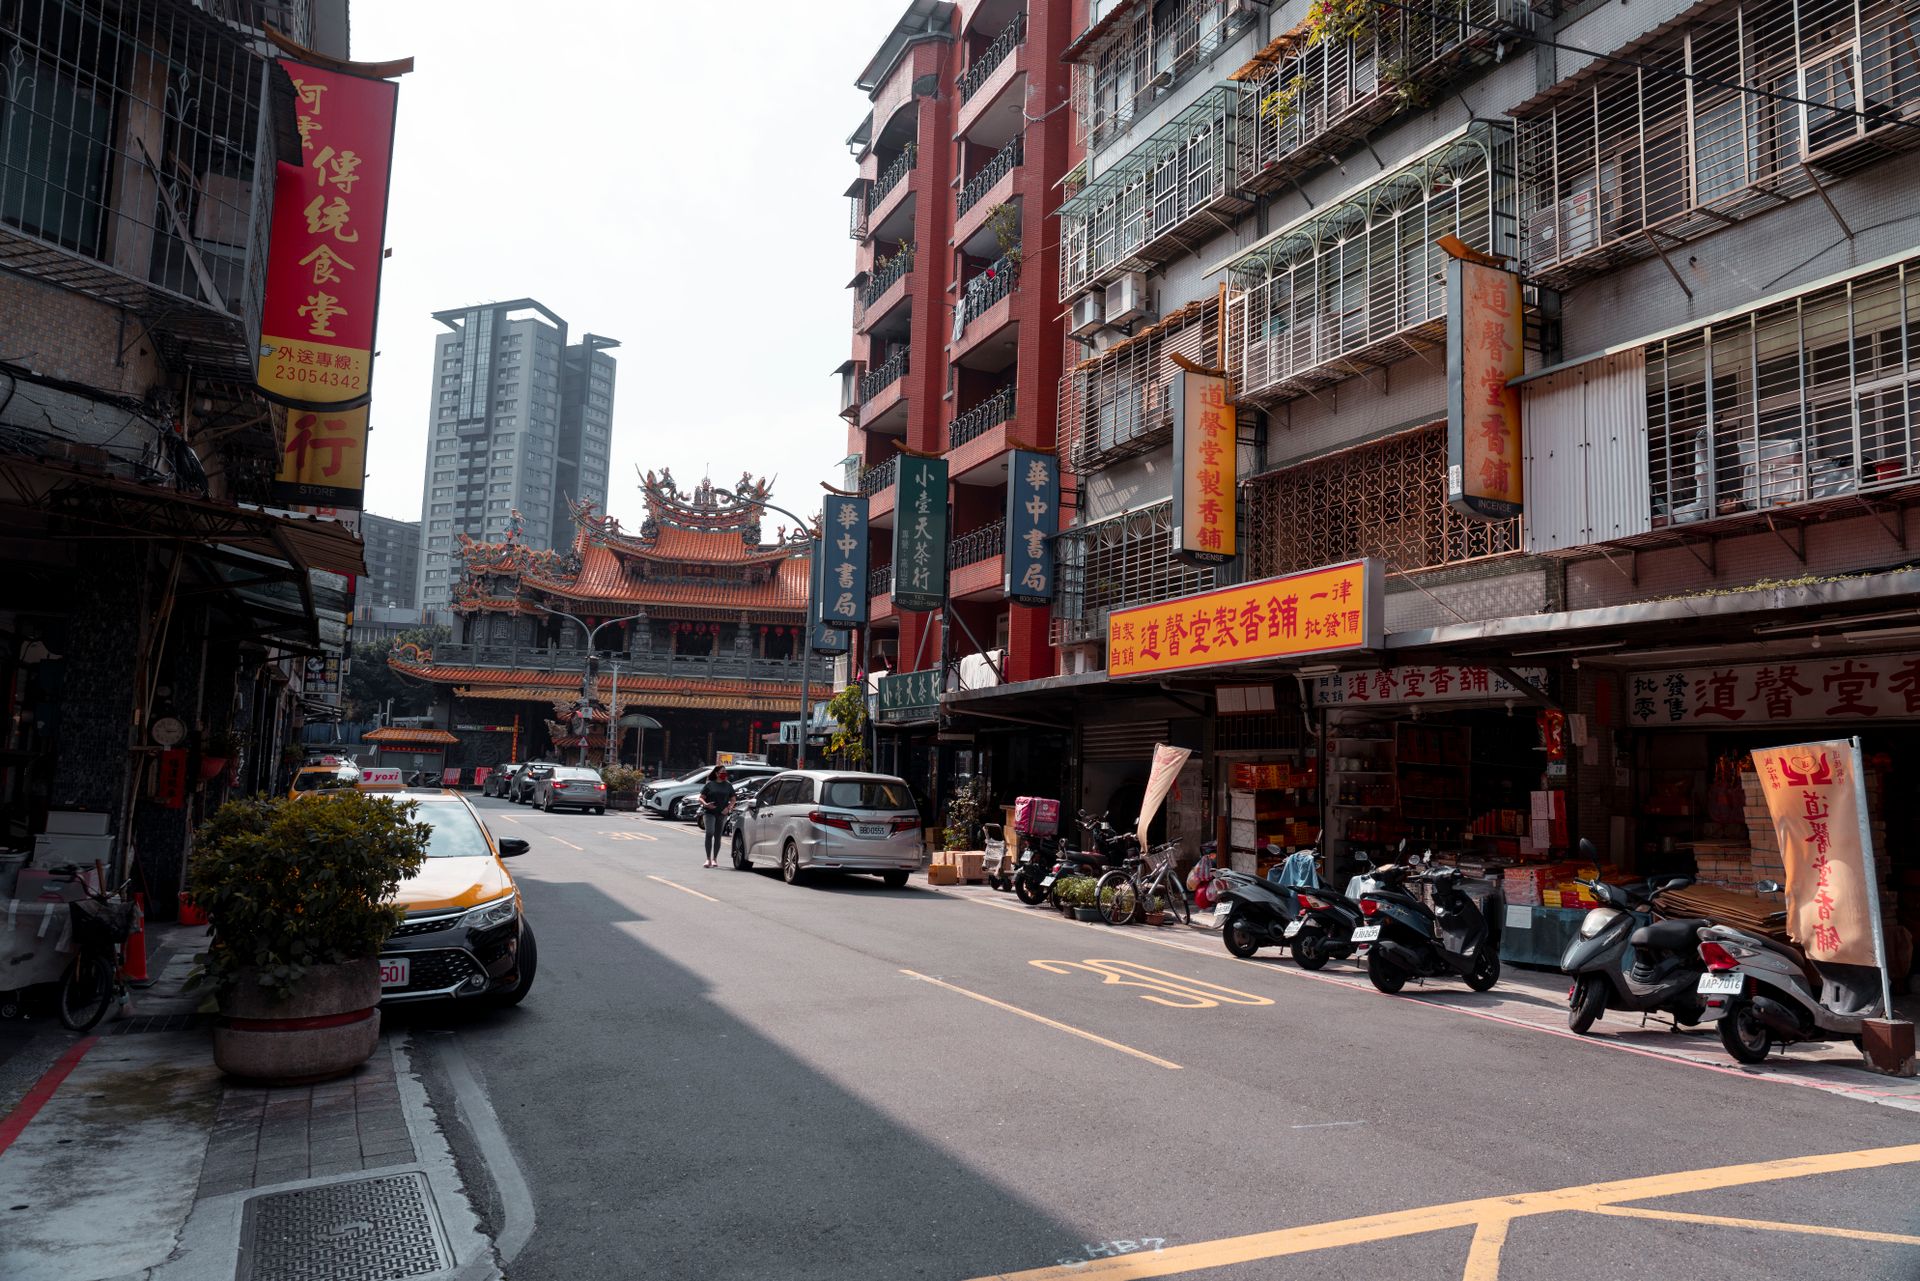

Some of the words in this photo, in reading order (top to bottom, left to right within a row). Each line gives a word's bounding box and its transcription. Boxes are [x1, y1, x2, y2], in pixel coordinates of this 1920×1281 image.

[297, 146, 362, 337] 傳統食堂
[275, 365, 360, 390] 23054342
[1479, 279, 1514, 494] 道馨堂香舖
[286, 414, 357, 477] 行
[1196, 384, 1227, 550] 道馨堂製香舖
[299, 485, 337, 496] STORE
[1478, 499, 1512, 513] INCENSE
[912, 463, 935, 591] 小壹天茶行
[1021, 459, 1050, 593] 華中書局
[833, 503, 859, 618] 華中書局
[1195, 552, 1224, 562] INCENSE
[1310, 578, 1353, 604] 一律
[820, 629, 837, 646] 局
[1111, 622, 1135, 642] 自製
[1140, 593, 1299, 661] 道馨堂製香舖
[1304, 609, 1361, 640] 批發價
[1111, 647, 1135, 667] 自銷
[1348, 666, 1489, 701] 道馨堂香舖
[374, 772, 399, 782] yoxi
[380, 965, 405, 983] 501
[1028, 959, 1276, 1009] 30
